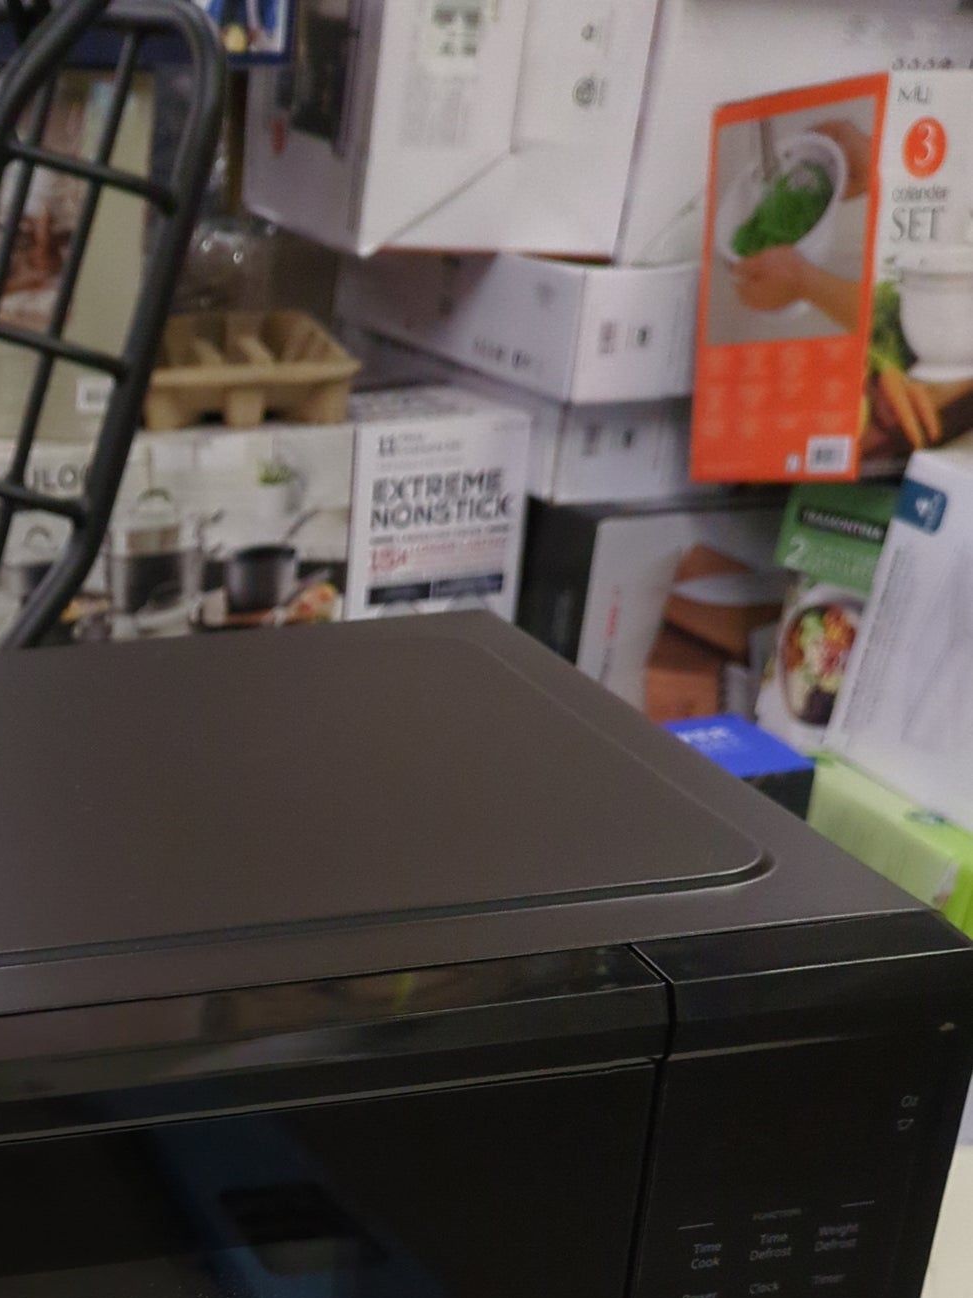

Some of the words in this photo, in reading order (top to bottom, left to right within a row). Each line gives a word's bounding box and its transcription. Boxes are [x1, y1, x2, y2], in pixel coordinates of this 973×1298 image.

[913, 121, 937, 168] 3
[890, 205, 945, 241] SET
[373, 468, 504, 504] EXTREME
[371, 495, 509, 530] NONSTICK
[784, 536, 808, 567] 2
[693, 1243, 723, 1254] Time
[759, 1233, 789, 1245] Time
[690, 1257, 721, 1270] Cook
[749, 1246, 792, 1261] Defrost
[748, 1281, 780, 1295] Clock
